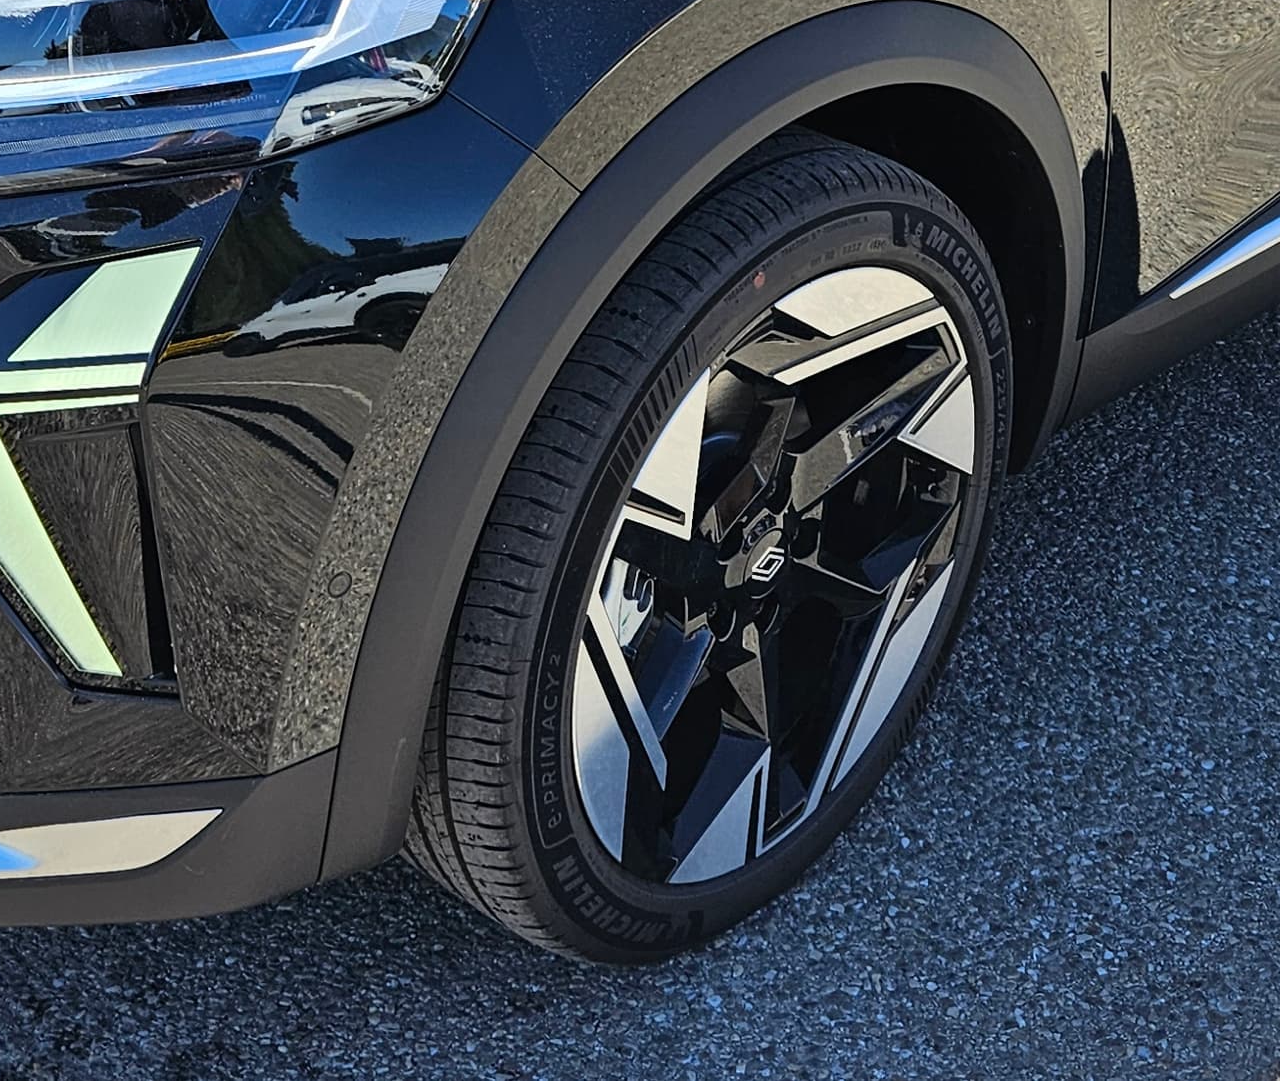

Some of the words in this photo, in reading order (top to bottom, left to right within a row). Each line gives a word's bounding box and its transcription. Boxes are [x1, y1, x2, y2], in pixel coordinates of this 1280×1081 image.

[925, 224, 1002, 340] MICHELIN
[551, 653, 561, 667] 2
[552, 854, 667, 943] MICHELIN
